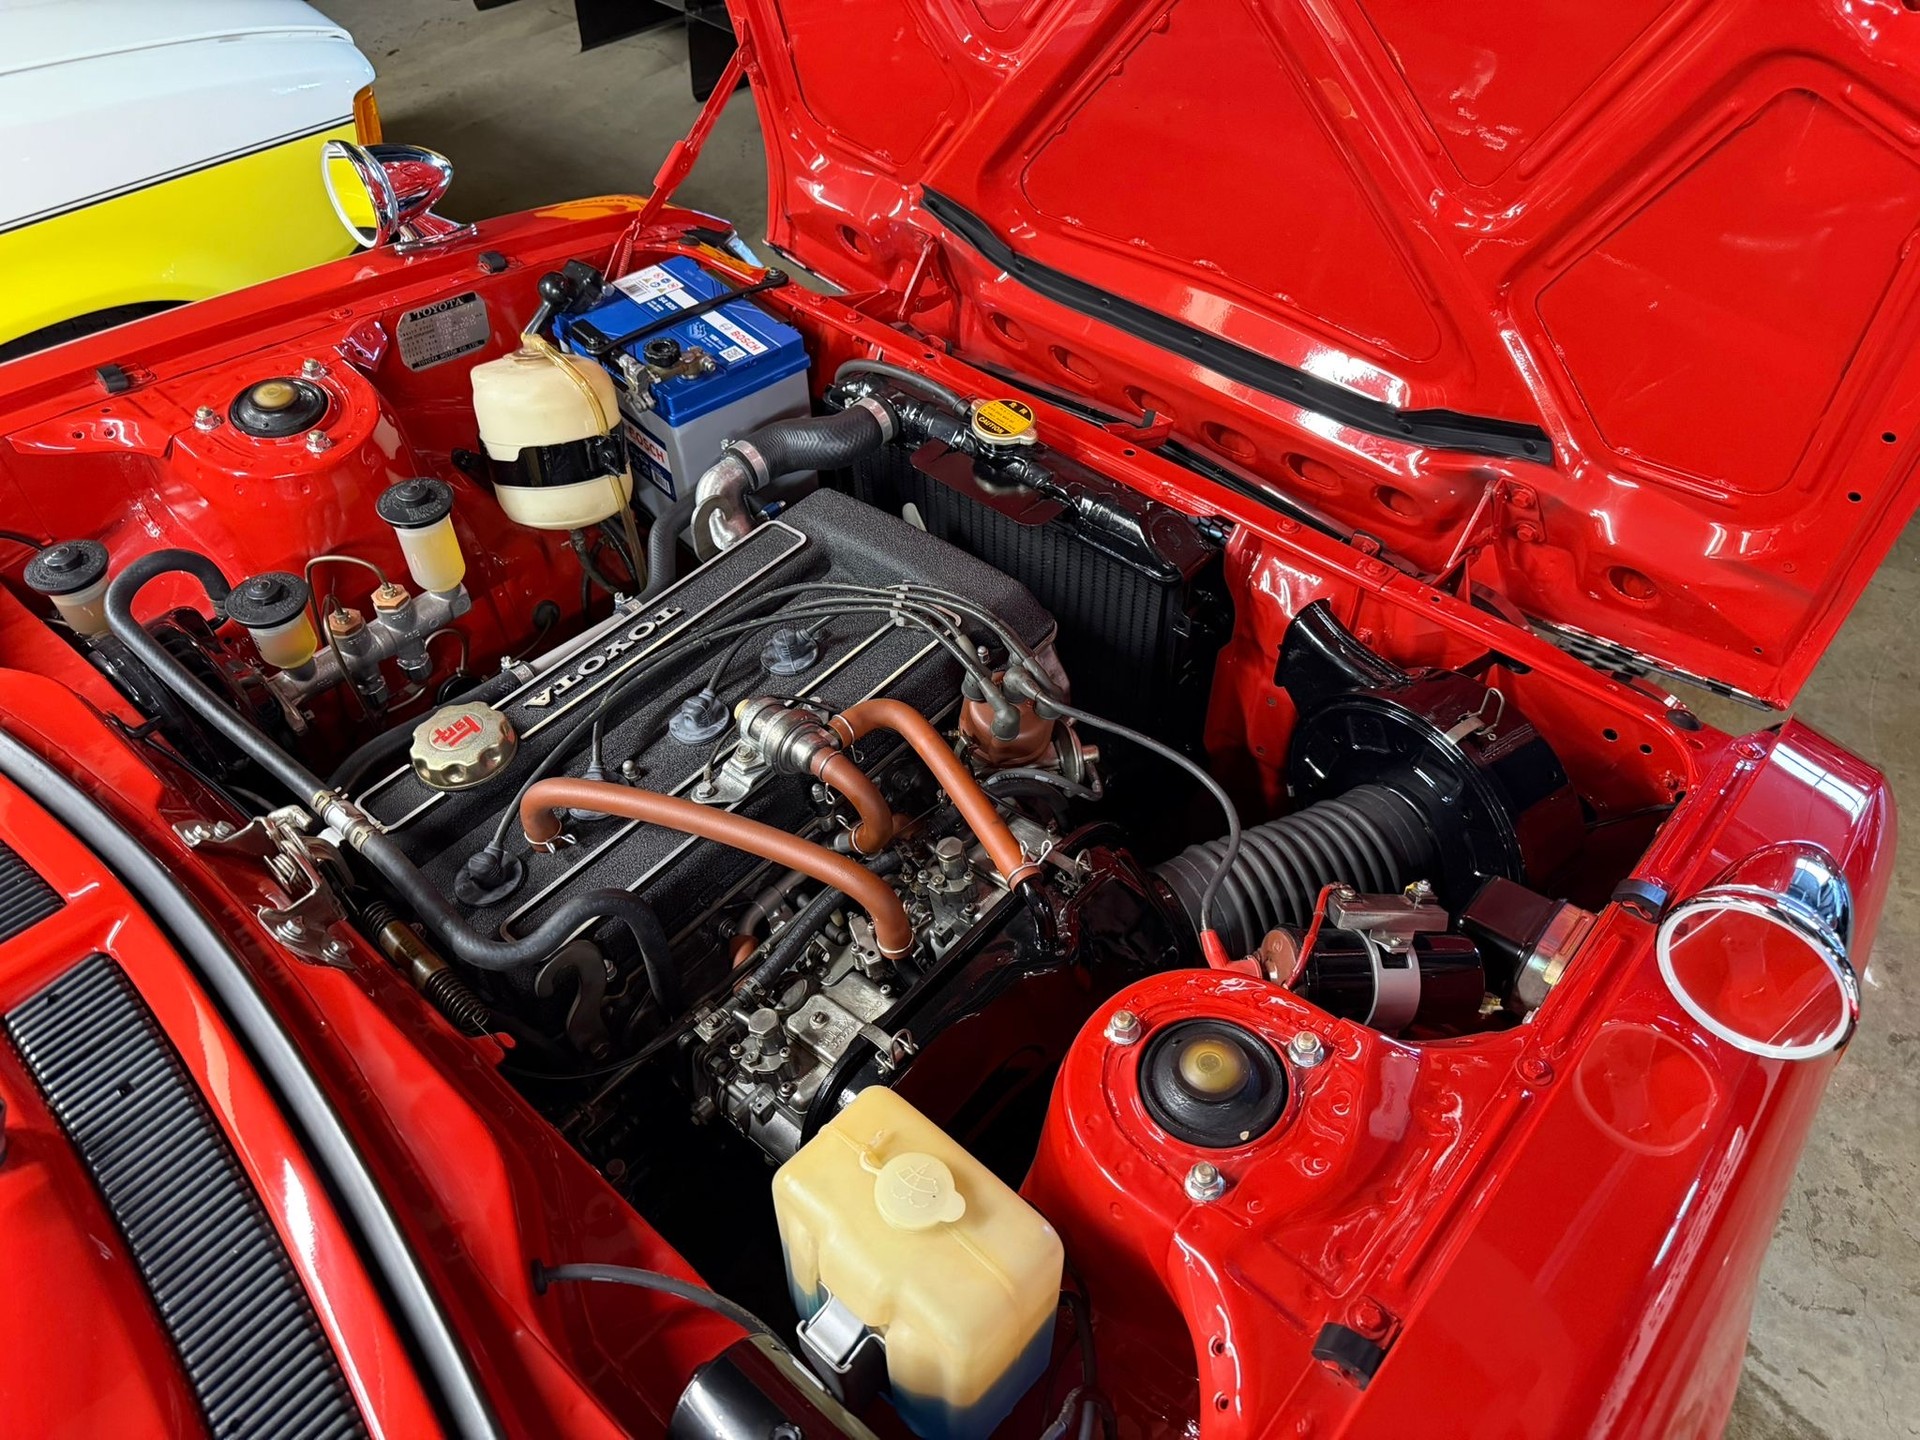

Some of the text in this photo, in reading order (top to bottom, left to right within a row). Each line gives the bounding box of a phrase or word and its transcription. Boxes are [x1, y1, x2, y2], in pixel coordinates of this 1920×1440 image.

[413, 297, 464, 319] TOYOTA
[730, 330, 761, 352] BOSCH
[978, 416, 1005, 434] CAUTION
[627, 425, 666, 463] BOSCH
[522, 606, 683, 709] TOYOTA
[818, 1015, 850, 1048] SOLEX
